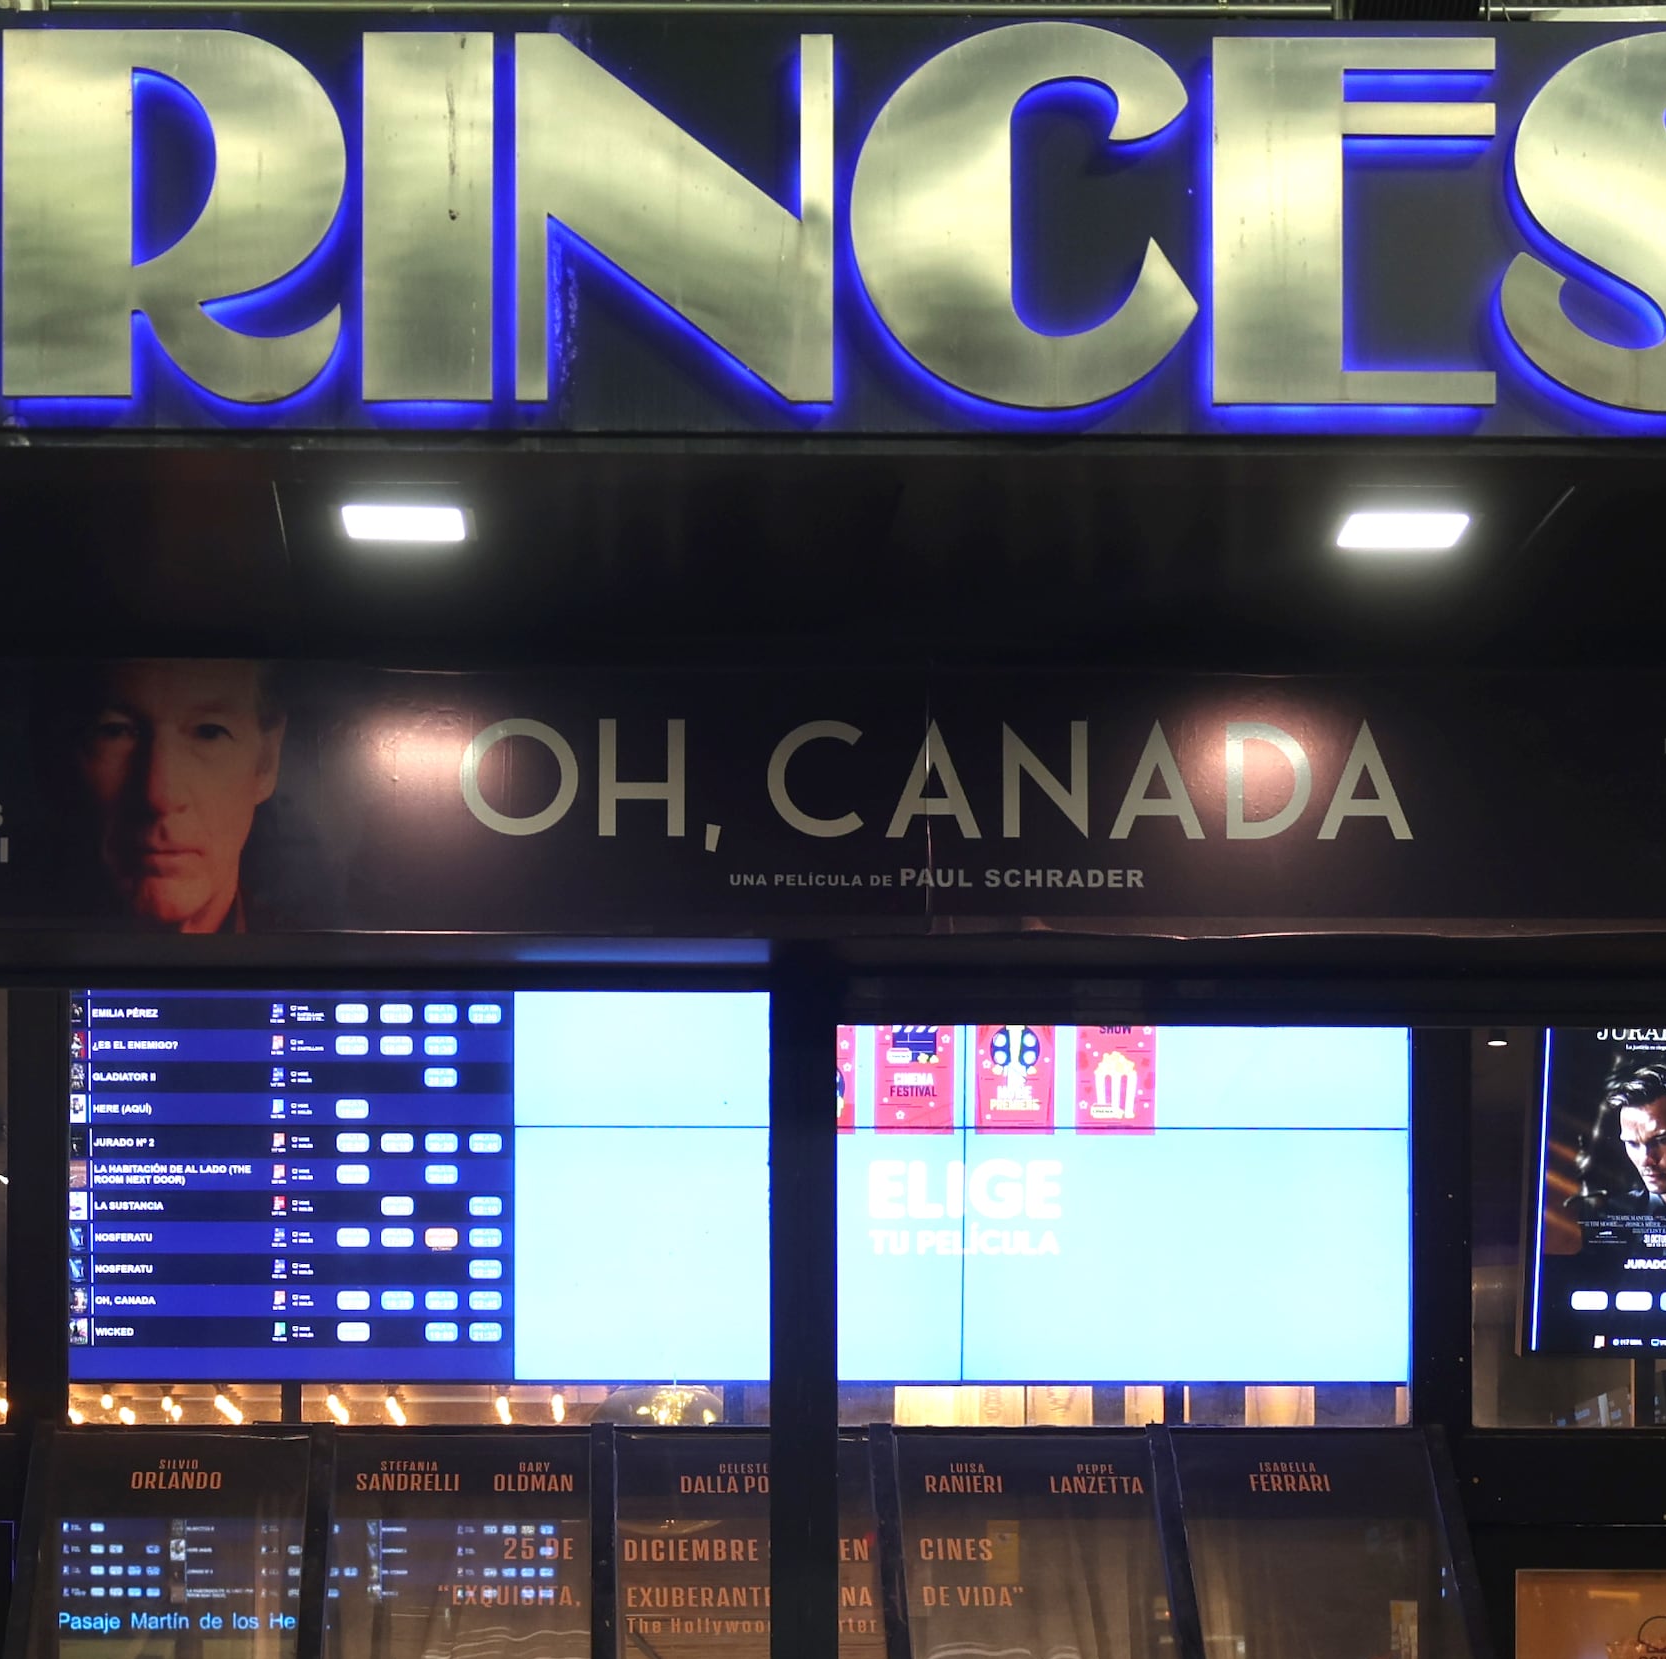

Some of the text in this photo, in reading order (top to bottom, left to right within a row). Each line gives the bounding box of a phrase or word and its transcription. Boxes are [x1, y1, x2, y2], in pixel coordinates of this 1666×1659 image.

[459, 716, 1414, 853] OH, CANADA
[728, 867, 1146, 890] UNA PELÍCULA DE PAUL SCHRADER
[91, 1006, 159, 1018] EMILIA PÉREZ
[113, 1040, 179, 1050] EL ENEMIGO?
[91, 1072, 149, 1082] GLADIATOR
[889, 1085, 938, 1097] FESTIVAL
[92, 1104, 120, 1114] HERE
[93, 1137, 156, 1148] JURADO 2
[93, 1162, 227, 1174] LA HABITACIÓN DE AL LADO
[93, 1175, 152, 1185] ROOM NEXT
[867, 1157, 1064, 1221] ELIGE
[93, 1201, 165, 1211] LA SUSTANCIA
[94, 1232, 154, 1243] NOSFERATU
[868, 1222, 1062, 1257] TU PELÍCULA
[94, 1264, 154, 1274] NOSFERATU
[113, 1295, 157, 1306] CANADA
[94, 1327, 135, 1337] WICKED
[158, 1458, 200, 1470] SILVIO
[379, 1460, 440, 1472] STEFANIA
[518, 1461, 552, 1473] GARY
[719, 1462, 769, 1474] CELESTE
[949, 1463, 985, 1474] LUISA
[1076, 1463, 1116, 1475] PEPPE
[1258, 1461, 1317, 1474] ISABELLA
[131, 1470, 223, 1491] ORLANDO
[355, 1471, 461, 1492] SANDRELLI
[493, 1473, 574, 1492] OLDMAN
[680, 1474, 739, 1494] DALLA
[924, 1474, 1004, 1494] RANIERI
[1049, 1474, 1145, 1495] LANZETTA
[1248, 1473, 1333, 1494] FERRARI
[503, 1536, 994, 1562] 25 DE DICIEMBRE EN CINES
[922, 1586, 951, 1607] DE
[58, 1611, 260, 1634] Pasaje Martín de los
[626, 1617, 663, 1635] The
